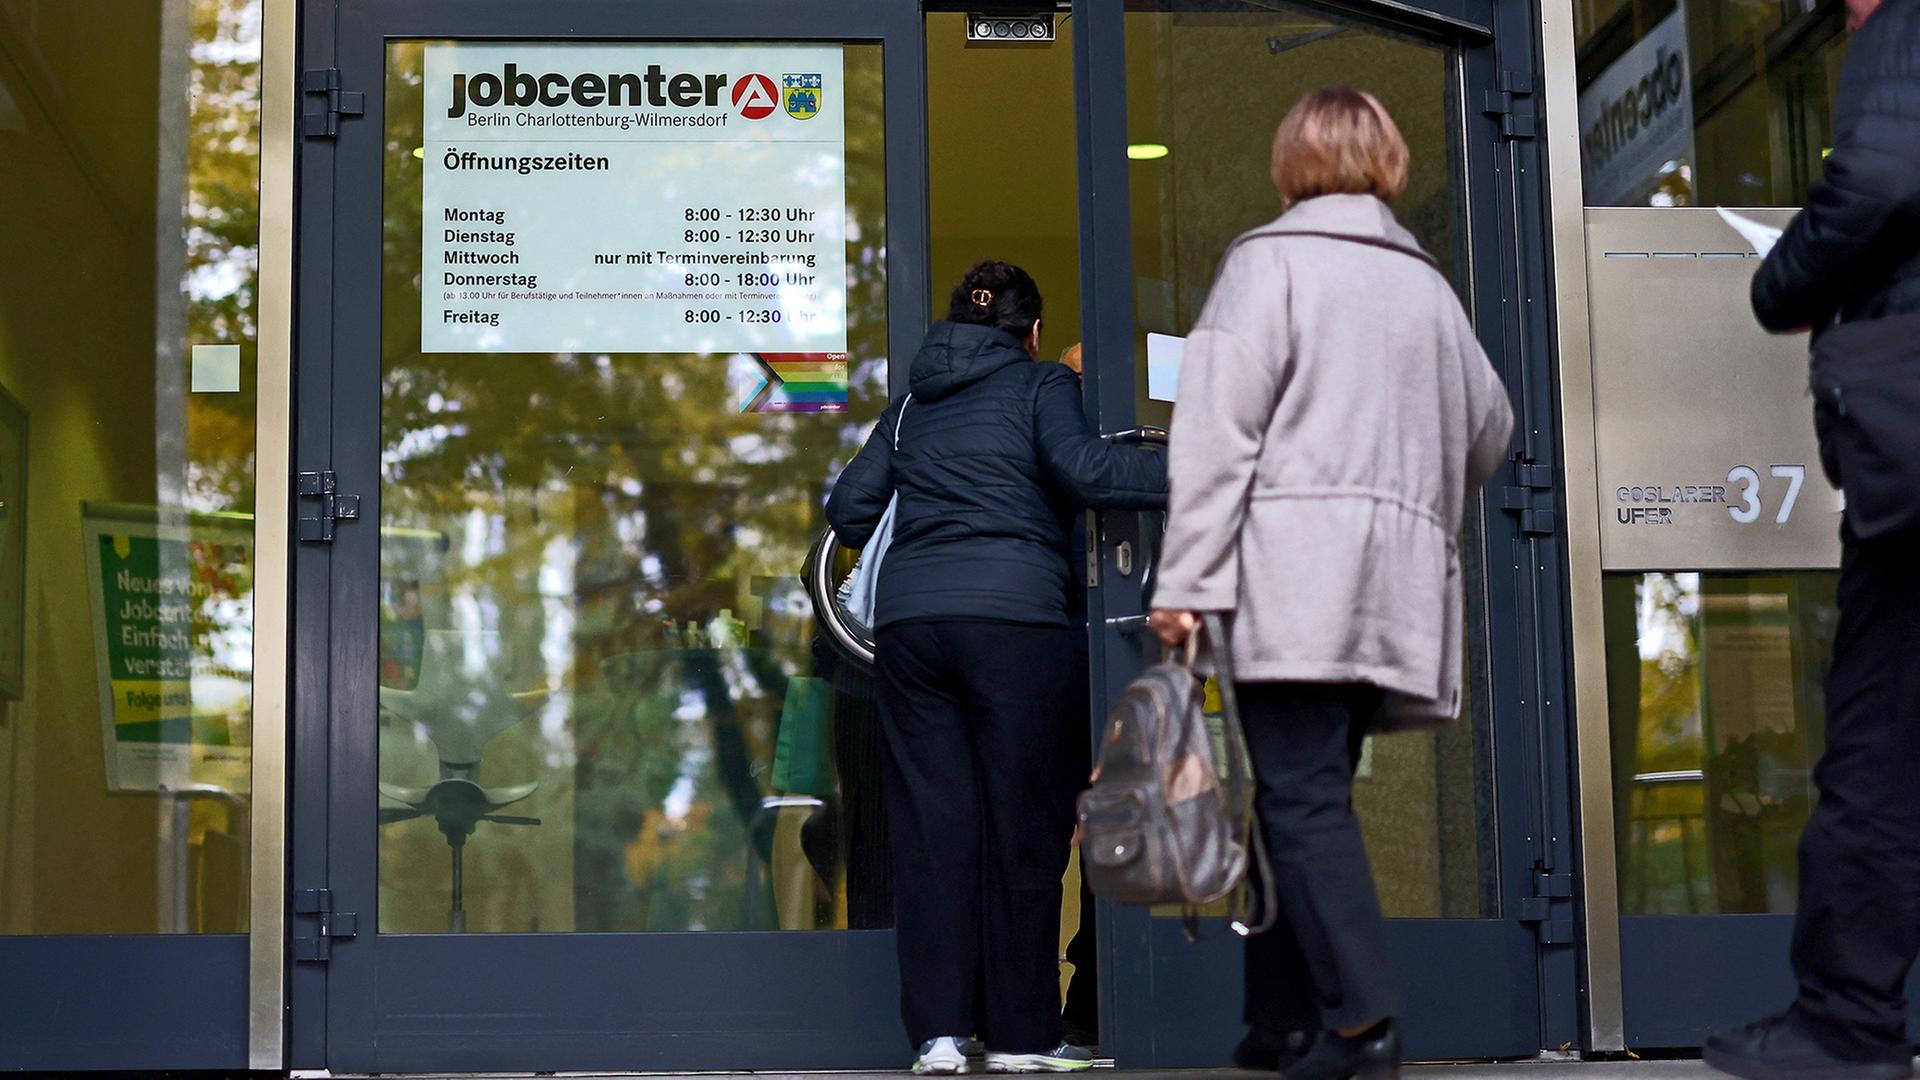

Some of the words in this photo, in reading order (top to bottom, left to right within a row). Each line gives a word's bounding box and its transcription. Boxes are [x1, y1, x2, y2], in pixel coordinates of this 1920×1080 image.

[448, 63, 728, 119] jobcenter
[468, 112, 511, 127] Berlin
[516, 112, 728, 130] Charlottenburg-Wilmersdorf
[443, 147, 609, 175] Öffnungszeiten
[444, 208, 505, 225] Montag
[684, 208, 720, 222] 8:00
[738, 208, 781, 222] 12:30
[786, 207, 816, 222] Uhr
[444, 229, 516, 246] Dienstag
[684, 229, 720, 243] 8:00
[738, 229, 780, 243] 12:30
[786, 229, 815, 243] Uhr
[444, 250, 520, 265] Mittwoch
[594, 254, 622, 265] nur
[626, 251, 653, 265] mit
[657, 251, 816, 268] Terminvereinbarung
[444, 272, 538, 289] Donnerstag
[684, 273, 720, 286] 8:00
[737, 273, 780, 286] 18:00
[786, 272, 816, 286] Uhr
[459, 292, 480, 300] 13.00
[482, 292, 496, 300] Uhr
[498, 291, 508, 300] für
[511, 291, 557, 302] Berufstätige
[559, 292, 574, 300] und
[656, 292, 703, 300] Maßnahmen
[705, 291, 723, 300] oder
[725, 292, 737, 300] mit
[443, 309, 500, 327] Freitag
[684, 310, 721, 323] 8:00
[739, 310, 781, 323] 12:30
[826, 352, 845, 362] Open
[1616, 485, 1726, 504] GOSLARER
[1726, 464, 1806, 525] 37
[1617, 507, 1672, 525] UFER
[117, 569, 173, 594] Neues
[121, 624, 189, 650] Einfach
